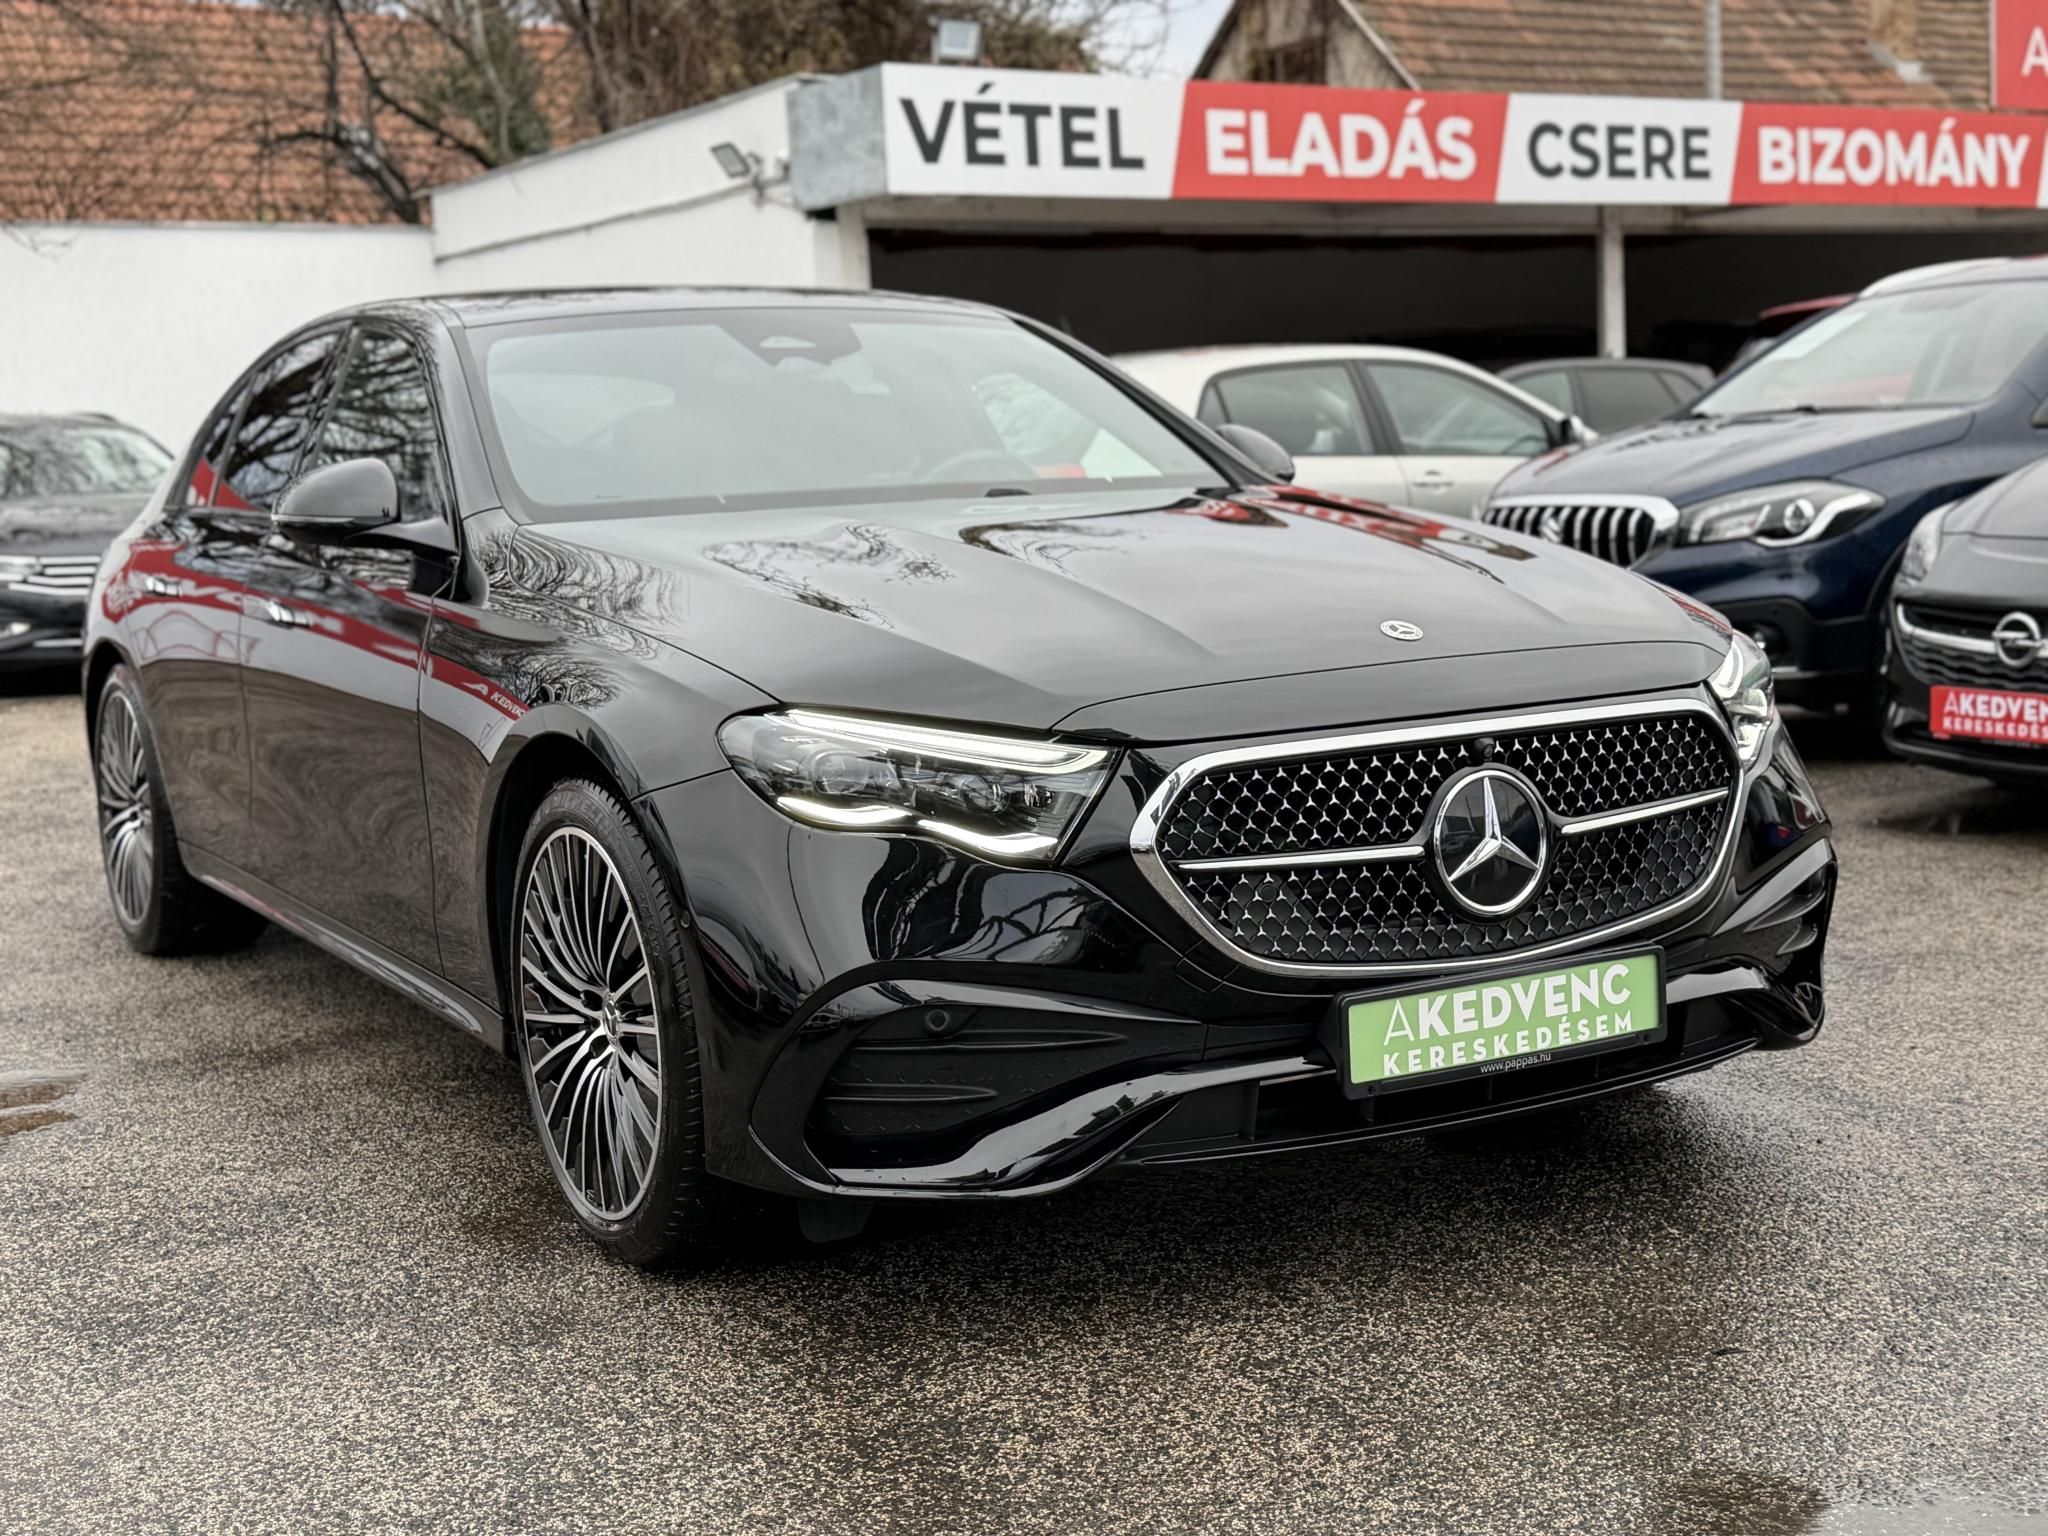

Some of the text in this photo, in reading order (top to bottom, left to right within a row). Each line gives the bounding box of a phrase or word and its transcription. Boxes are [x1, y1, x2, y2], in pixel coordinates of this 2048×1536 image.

[901, 83, 2031, 188] VÉTEL ELADÁS CSERE BIZOMÁNY
[1382, 1009, 1633, 1076] KERESKEDÉSEM
[1480, 1052, 1552, 1073] www.pappas.hu
